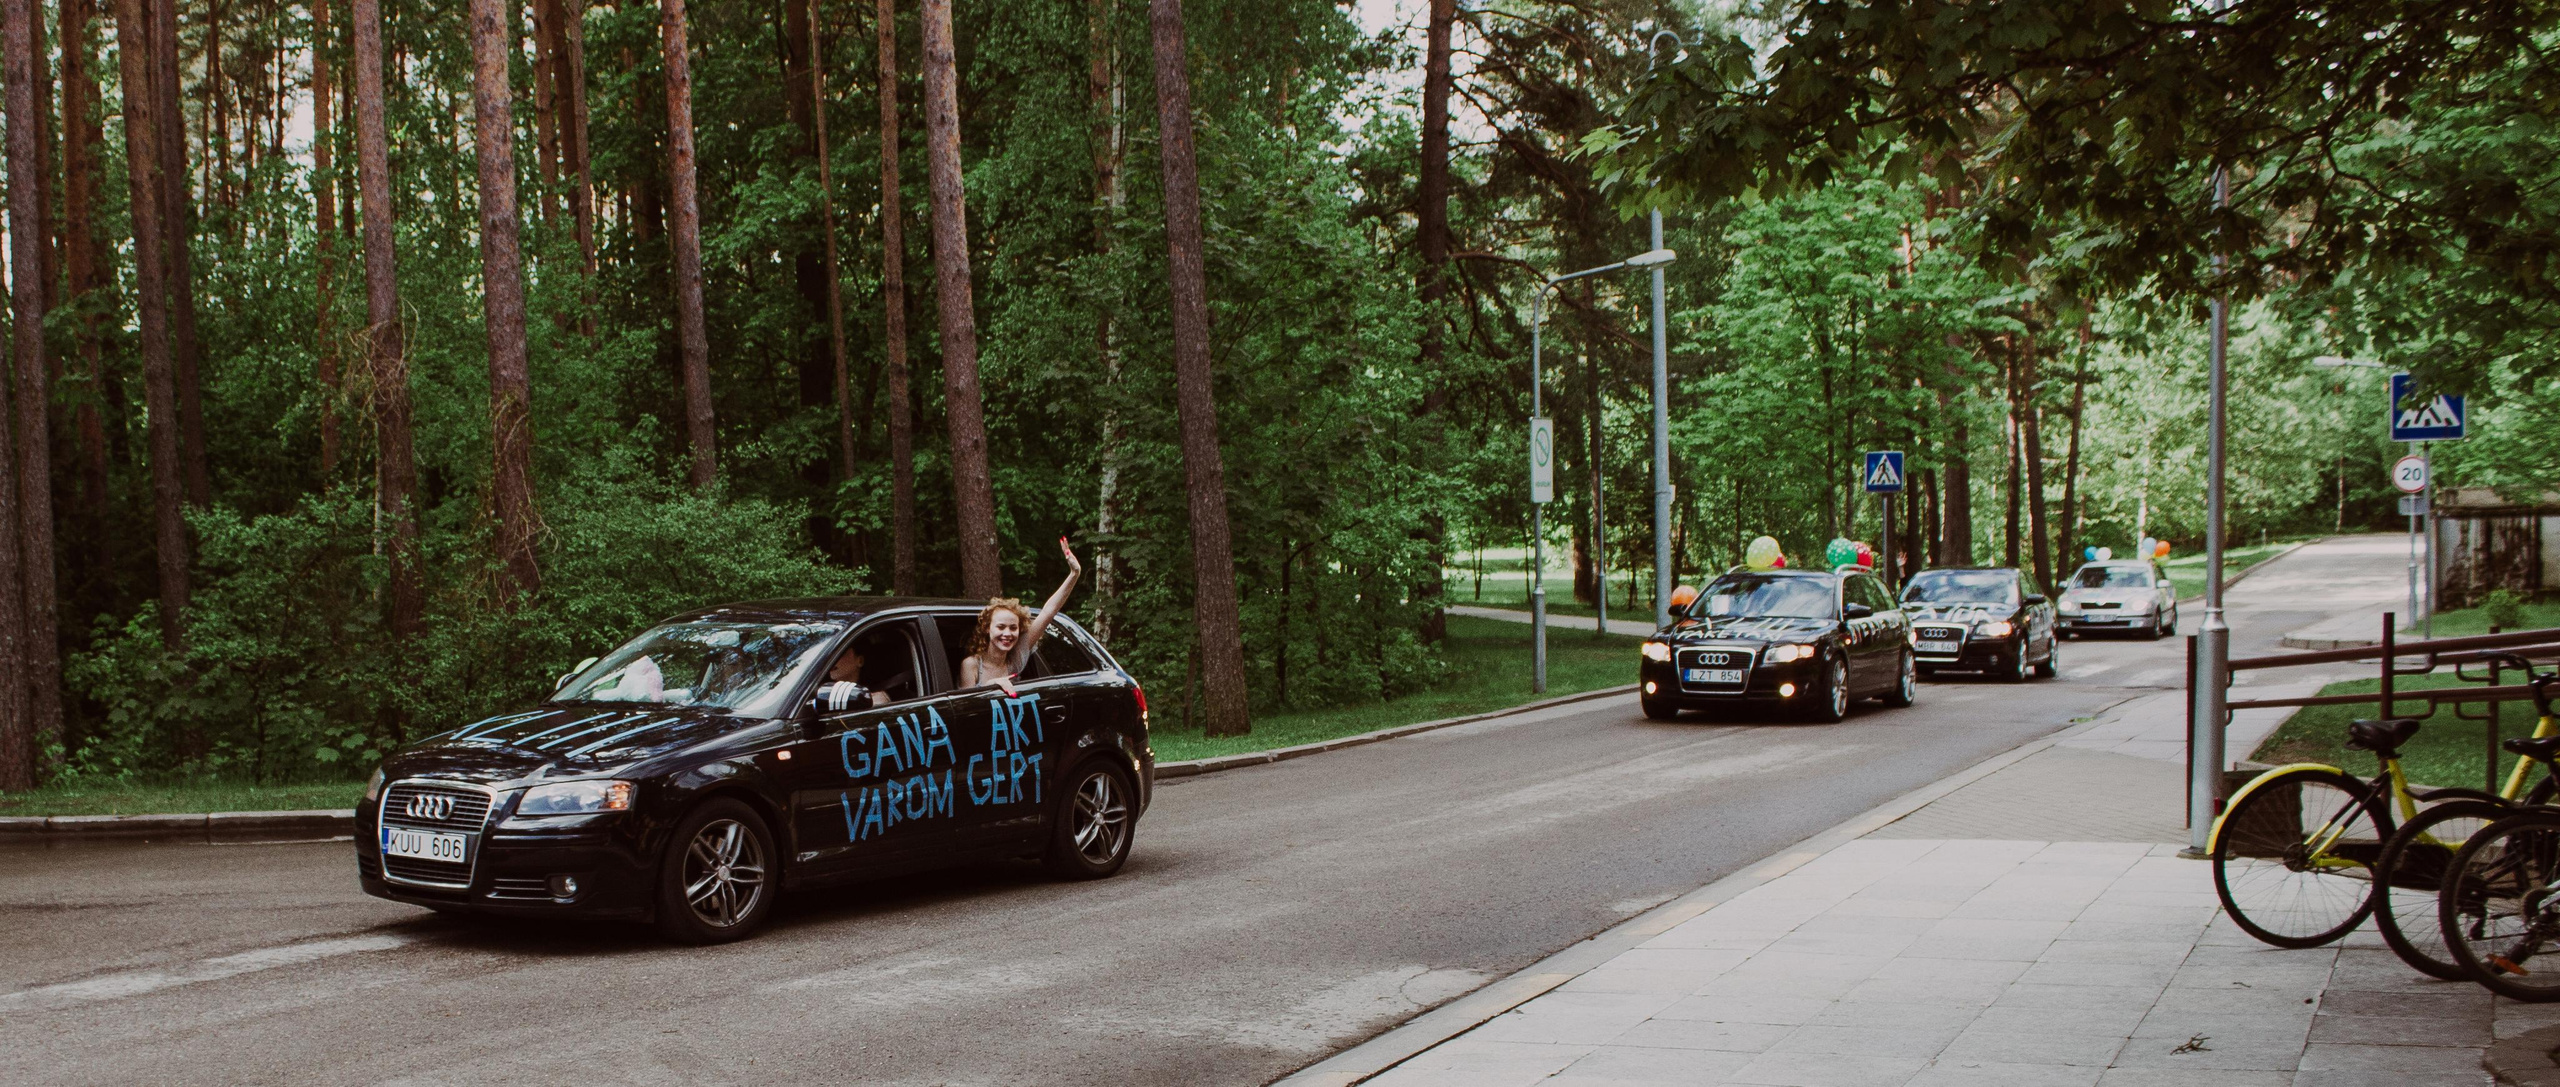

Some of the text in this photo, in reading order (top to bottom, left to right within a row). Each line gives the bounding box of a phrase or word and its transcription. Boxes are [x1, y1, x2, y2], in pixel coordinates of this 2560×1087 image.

[2402, 467, 2422, 481] 20
[1691, 670, 1740, 681] LZT 854
[840, 693, 1044, 778] GANA ART
[840, 750, 1043, 843] VAROM GERT
[390, 832, 462, 859] KUU 606
